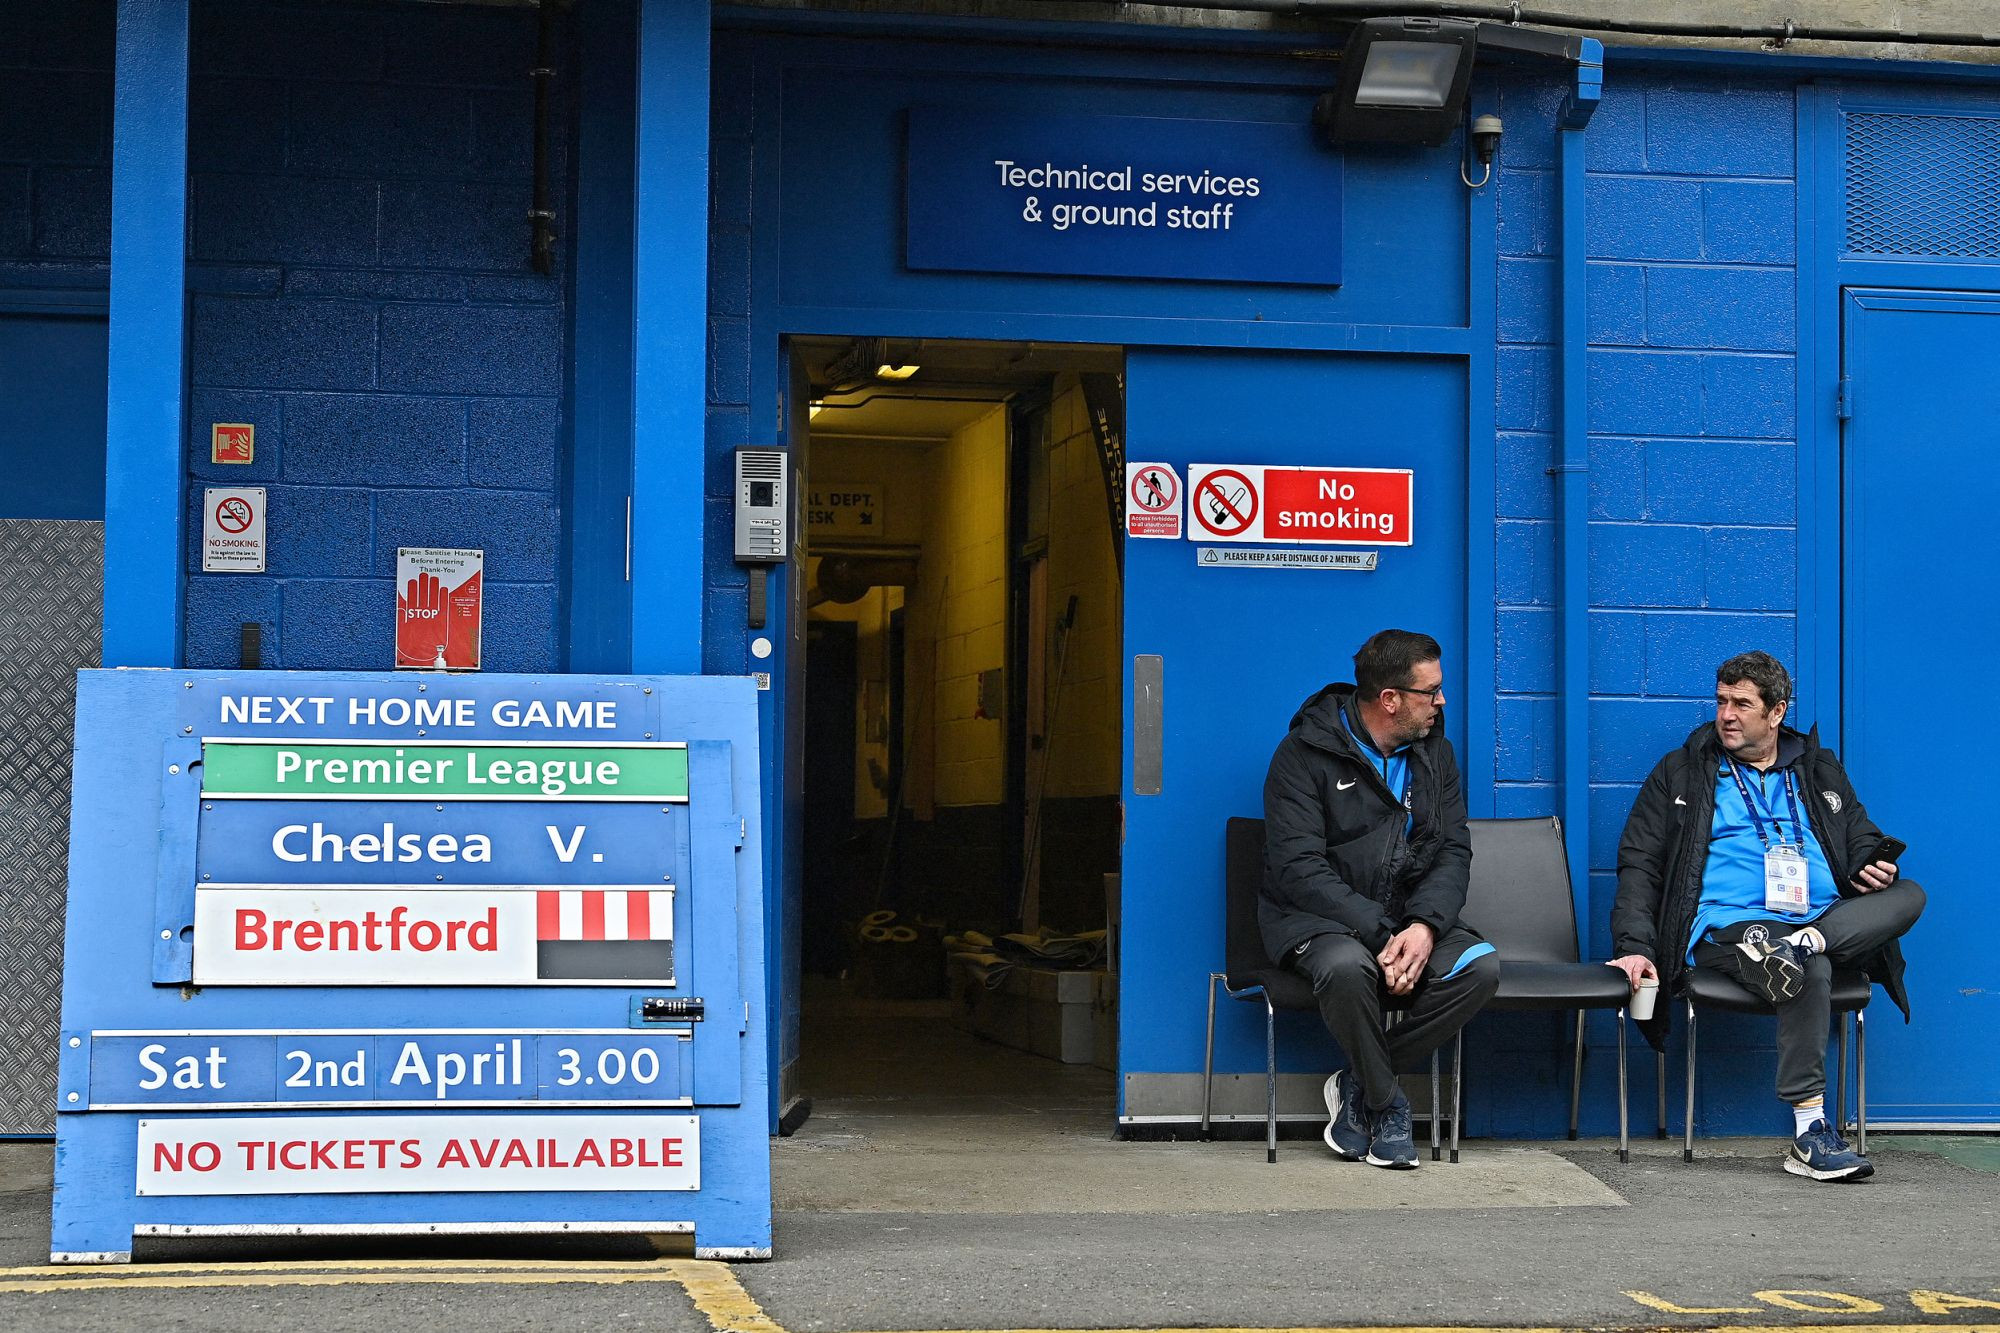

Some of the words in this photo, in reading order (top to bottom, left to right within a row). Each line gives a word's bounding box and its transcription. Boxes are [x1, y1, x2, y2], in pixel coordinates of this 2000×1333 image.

[995, 160, 1131, 191] Technical
[1142, 169, 1260, 197] services
[1022, 196, 1042, 222] &
[1052, 201, 1156, 230] ground
[1166, 202, 1233, 230] staff
[1097, 407, 1114, 464] THE
[830, 493, 874, 507] DEPT.
[1319, 478, 1355, 500] No
[808, 511, 834, 524] ESK
[1278, 507, 1394, 535] smoking
[435, 558, 464, 566] Entering
[1224, 552, 1247, 560] PLEASE
[1249, 553, 1265, 561] KEEP
[1289, 554, 1319, 562] DISTANCE
[1329, 555, 1333, 563] 2
[1335, 555, 1360, 563] METRES
[408, 608, 438, 619] STOP
[220, 696, 334, 725] NEXT
[348, 697, 476, 727] HOME
[491, 699, 617, 729] GAME
[276, 749, 454, 785] Premier
[467, 752, 620, 796] League
[271, 822, 491, 863] Chelsea
[546, 825, 604, 863] V.
[235, 906, 498, 952] Brentford
[138, 1044, 227, 1090] Sat
[285, 1049, 366, 1088] 2nd
[390, 1038, 523, 1099] April
[557, 1047, 660, 1086] 3.00
[153, 1142, 221, 1172] NO
[237, 1139, 422, 1171] TICKETS
[437, 1137, 683, 1169] AVAILABLE
[1618, 1288, 2000, 1314] LOA
